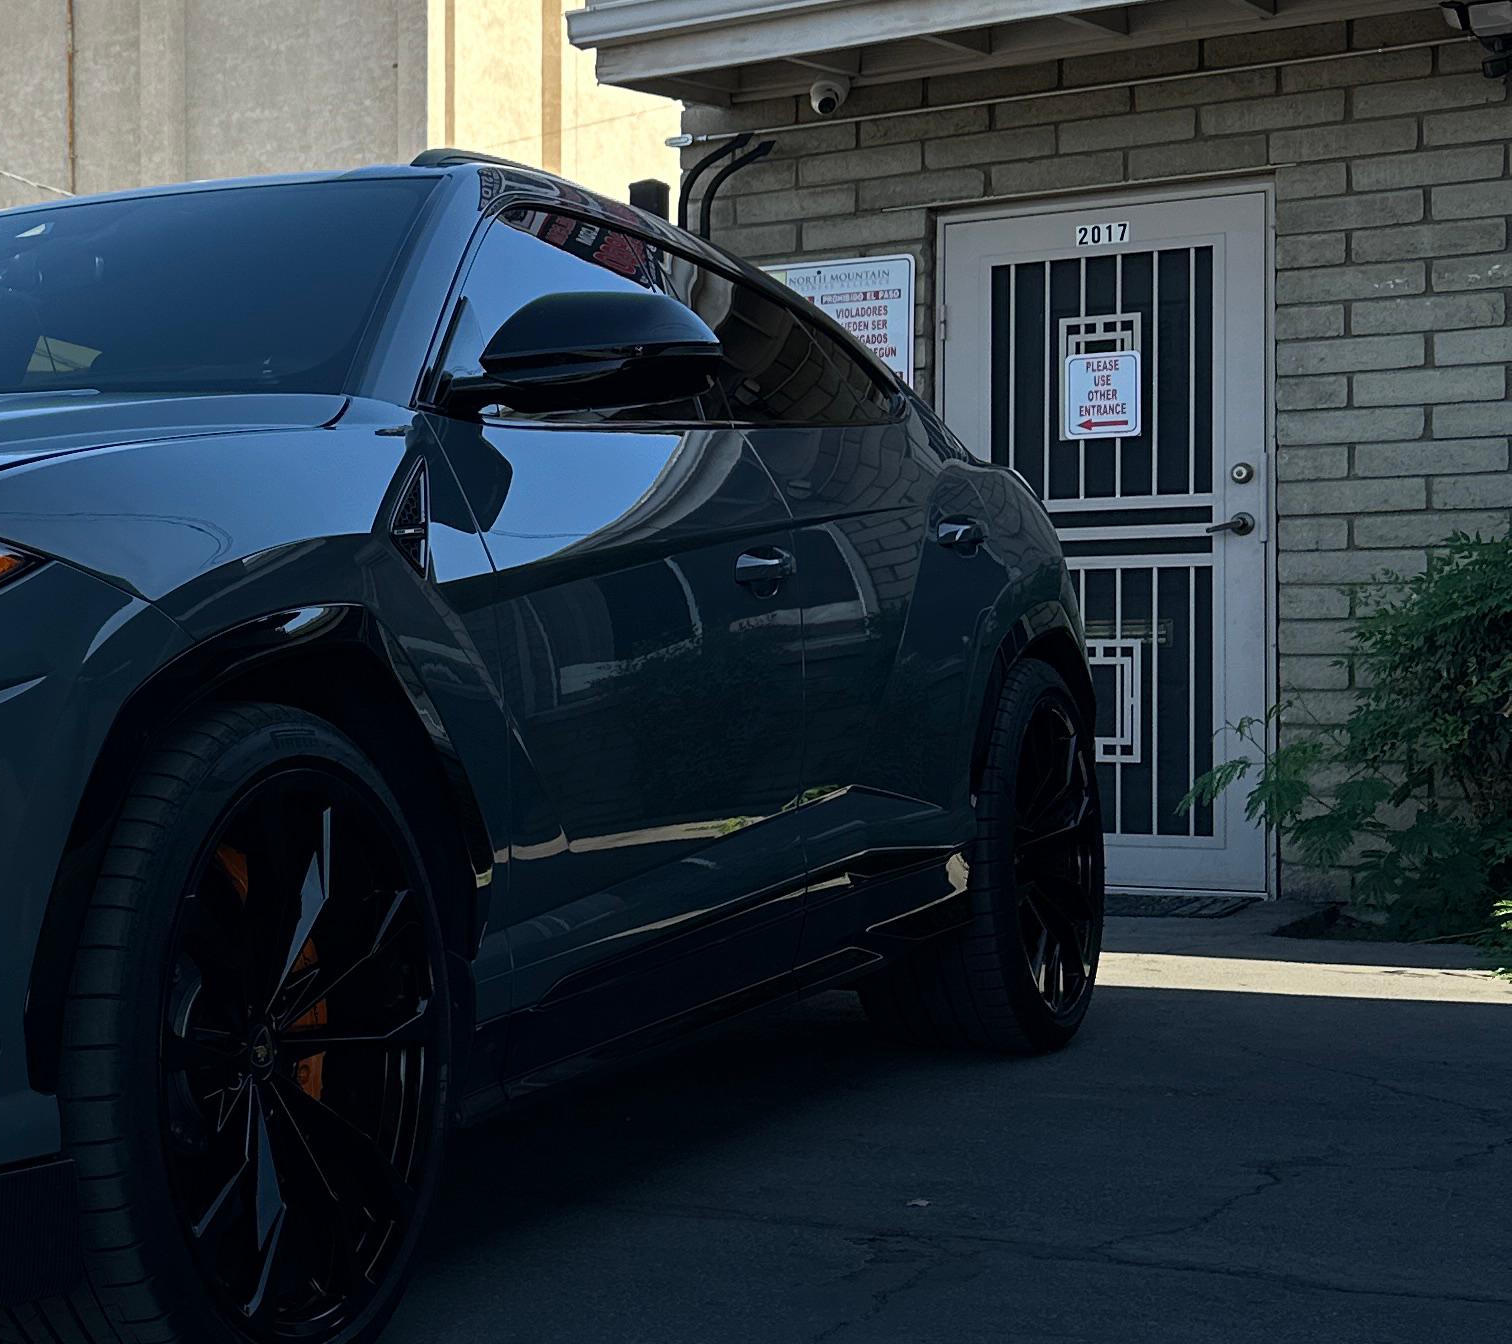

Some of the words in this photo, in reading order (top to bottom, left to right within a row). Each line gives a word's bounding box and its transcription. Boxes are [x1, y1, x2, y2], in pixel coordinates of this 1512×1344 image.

[1078, 223, 1128, 245] 2017
[789, 273, 826, 286] NORTH
[830, 269, 890, 282] MOUNTAIN
[867, 291, 876, 301] EL
[878, 289, 900, 300] PASO
[835, 305, 888, 319] VIOLADORES
[871, 319, 888, 331] SER
[859, 333, 888, 344] GADOS
[1086, 359, 1120, 373] PLEASE
[1093, 374, 1111, 387] USE
[1087, 388, 1118, 401] OTHER
[1079, 402, 1127, 417] ENTRANCE
